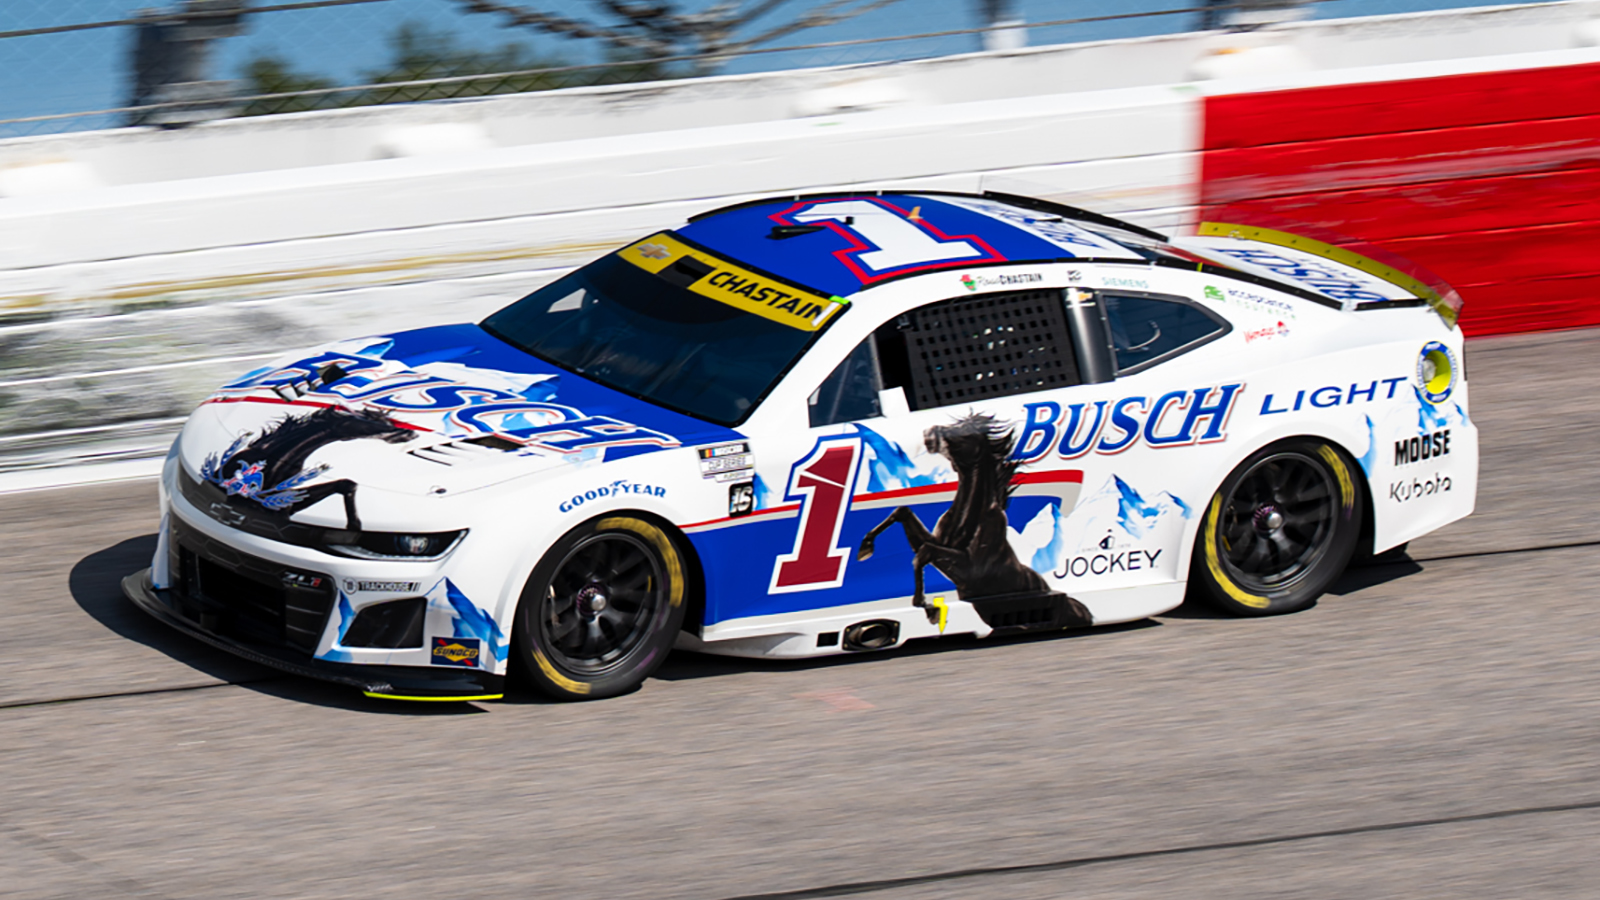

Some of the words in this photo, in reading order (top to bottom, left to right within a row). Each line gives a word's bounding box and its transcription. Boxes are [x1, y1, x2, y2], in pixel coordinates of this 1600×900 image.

[785, 198, 990, 275] 1
[708, 271, 827, 322] CHASTAIN
[1102, 277, 1149, 289] SIEMENS
[218, 351, 682, 454] BUSCH
[1009, 382, 1246, 464] BUSCH
[1258, 376, 1409, 415] LIGHT
[1395, 430, 1451, 466] MOOSE
[1390, 472, 1453, 503] Kubota
[767, 434, 863, 595] 1
[1053, 549, 1162, 579] JOCKEY
[434, 647, 479, 658] SUNOCO
